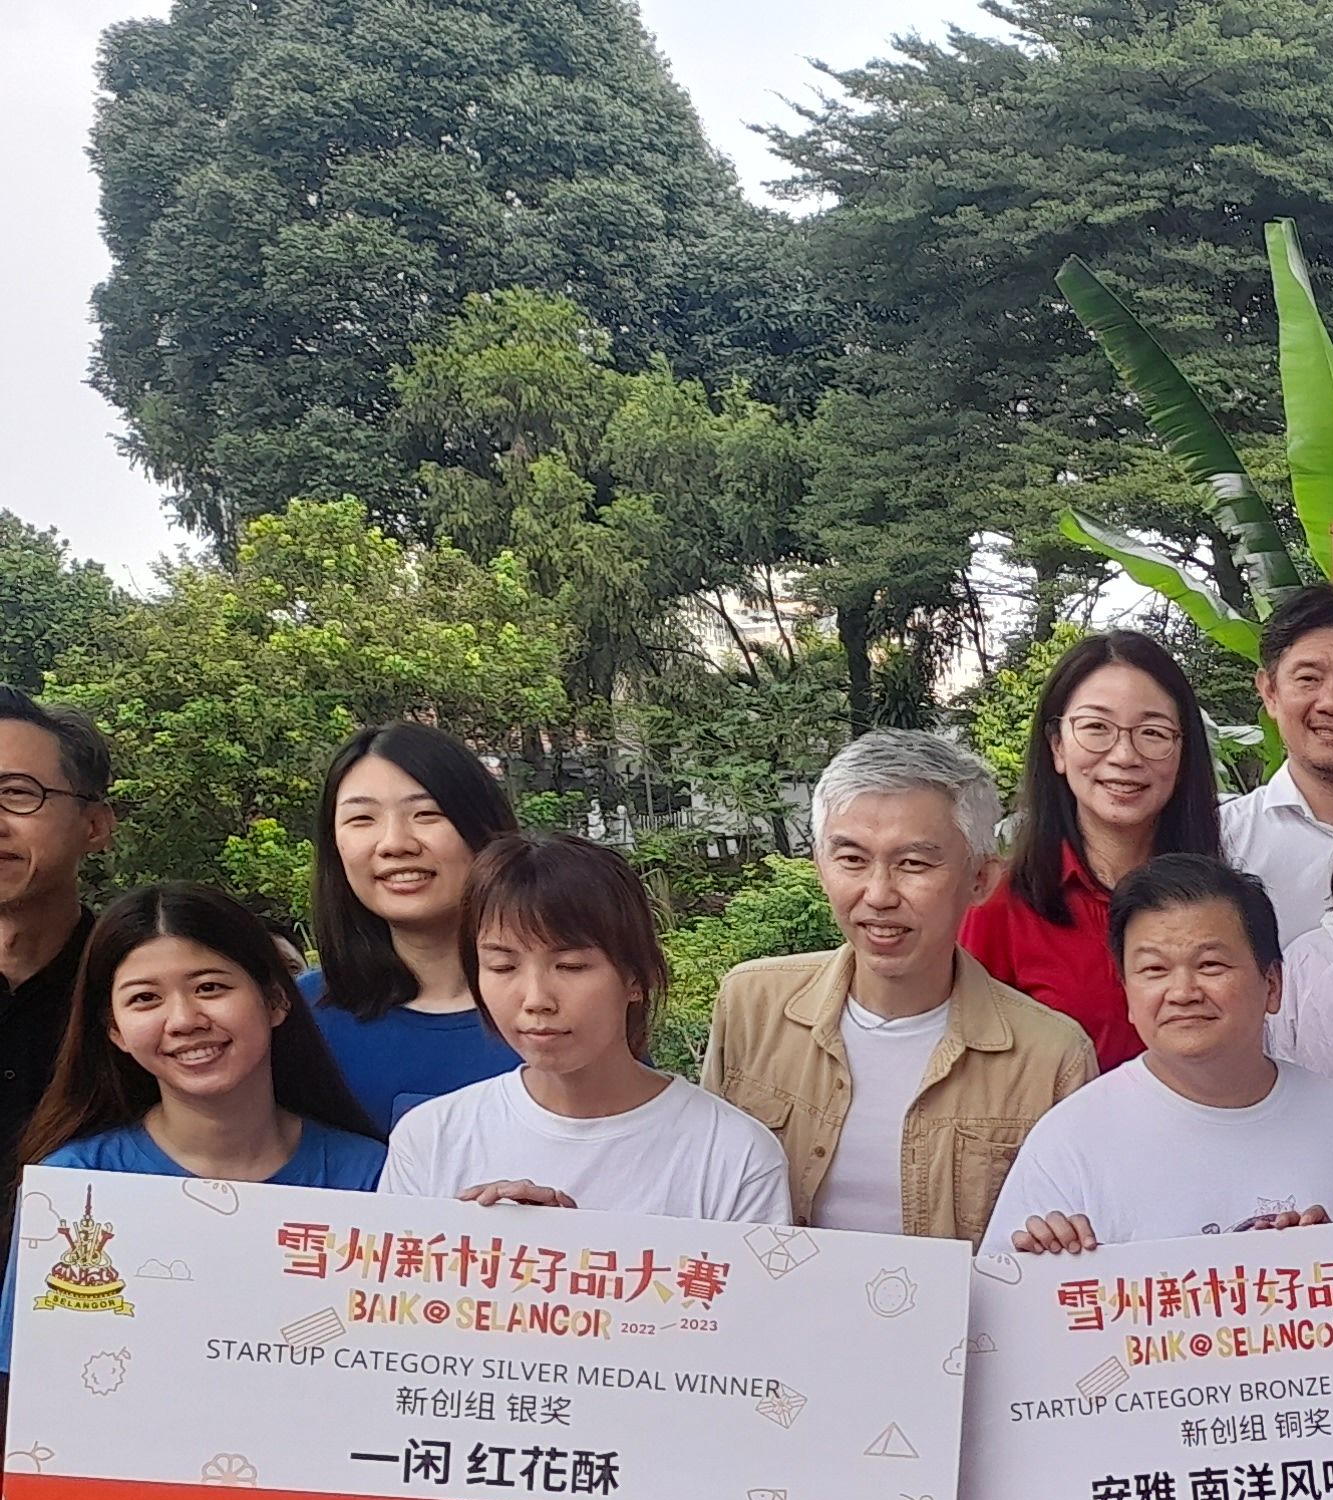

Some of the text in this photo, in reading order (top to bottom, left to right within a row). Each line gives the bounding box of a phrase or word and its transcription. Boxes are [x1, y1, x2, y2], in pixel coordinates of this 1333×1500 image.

[52, 1294, 116, 1310] SELANGOR
[621, 1321, 656, 1336] 2022
[679, 1318, 719, 1333] 2023
[205, 1337, 782, 1399] STARTUP CATEGORY SILVER MEDAL WINNER
[395, 1387, 572, 1428] 新创组 银奖
[1010, 1394, 1108, 1423] STARTUP
[1114, 1384, 1231, 1414] CATEGORY
[1239, 1376, 1332, 1403] BRONZE
[1180, 1409, 1332, 1447] 新创组 铜奖
[349, 1439, 621, 1497] 一闲 红花酥
